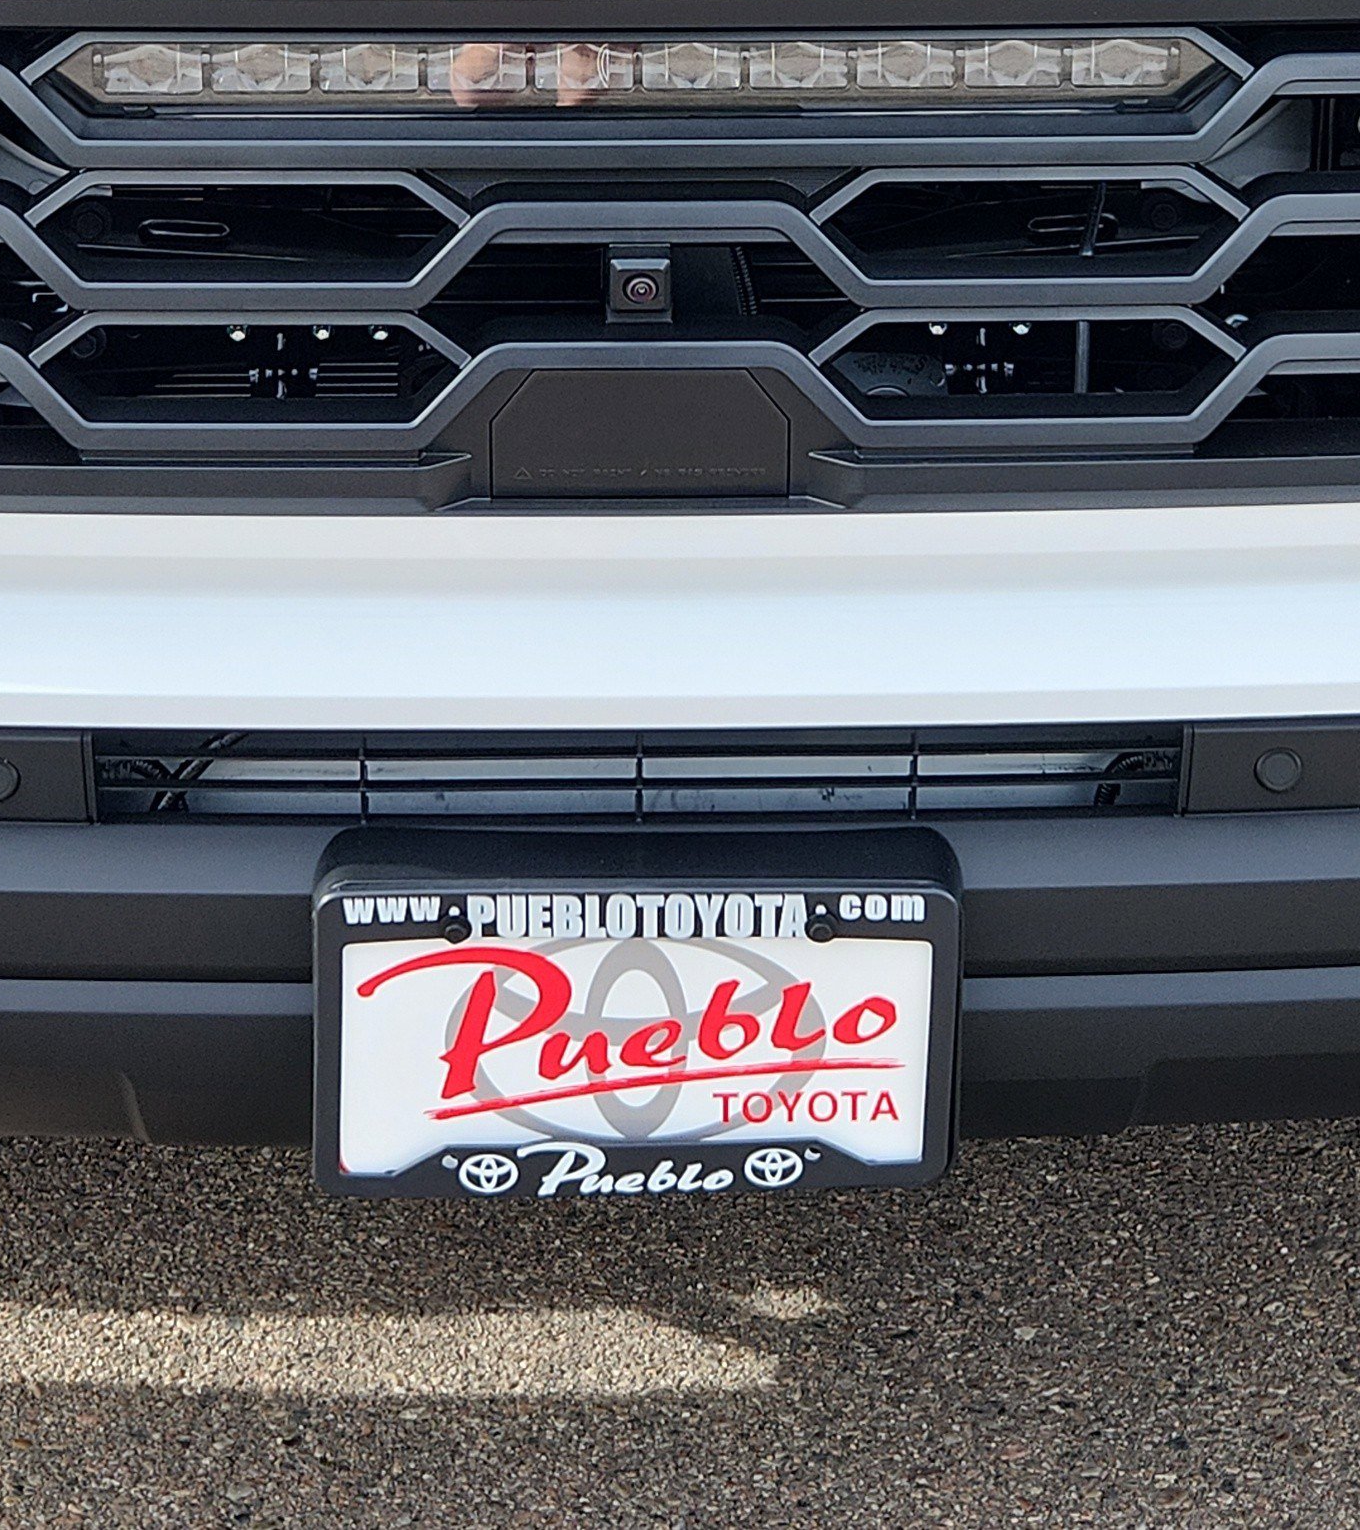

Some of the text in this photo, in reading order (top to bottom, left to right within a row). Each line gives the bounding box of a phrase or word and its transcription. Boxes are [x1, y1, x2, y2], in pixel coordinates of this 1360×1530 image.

[467, 893, 807, 939] PUEBLOTOYOTA
[356, 946, 898, 1099] Pueblo
[713, 1090, 899, 1124] TOYOTA
[517, 1140, 734, 1197] Pueblo
